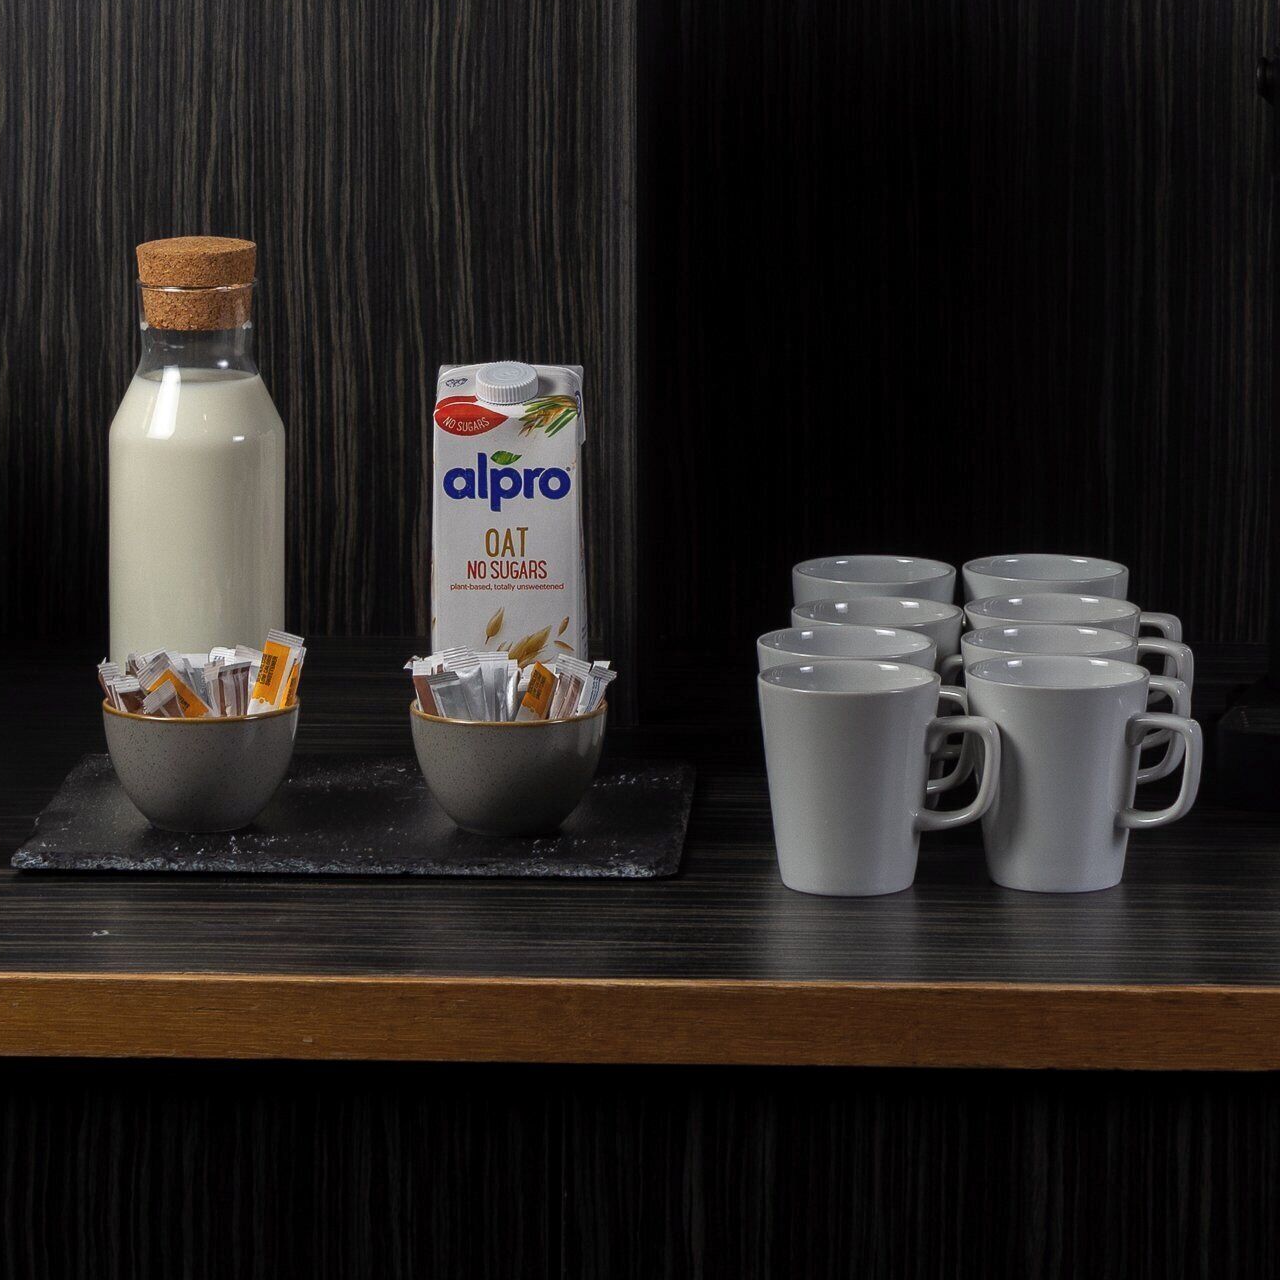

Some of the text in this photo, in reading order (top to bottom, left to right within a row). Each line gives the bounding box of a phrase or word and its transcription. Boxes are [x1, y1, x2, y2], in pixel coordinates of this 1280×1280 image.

[442, 416, 490, 432] NO SUGARS
[442, 452, 572, 513] alpro
[485, 526, 529, 558] OAT
[467, 560, 548, 580] NO SUGARS
[449, 582, 565, 592] plant-based, totally unsweetened
